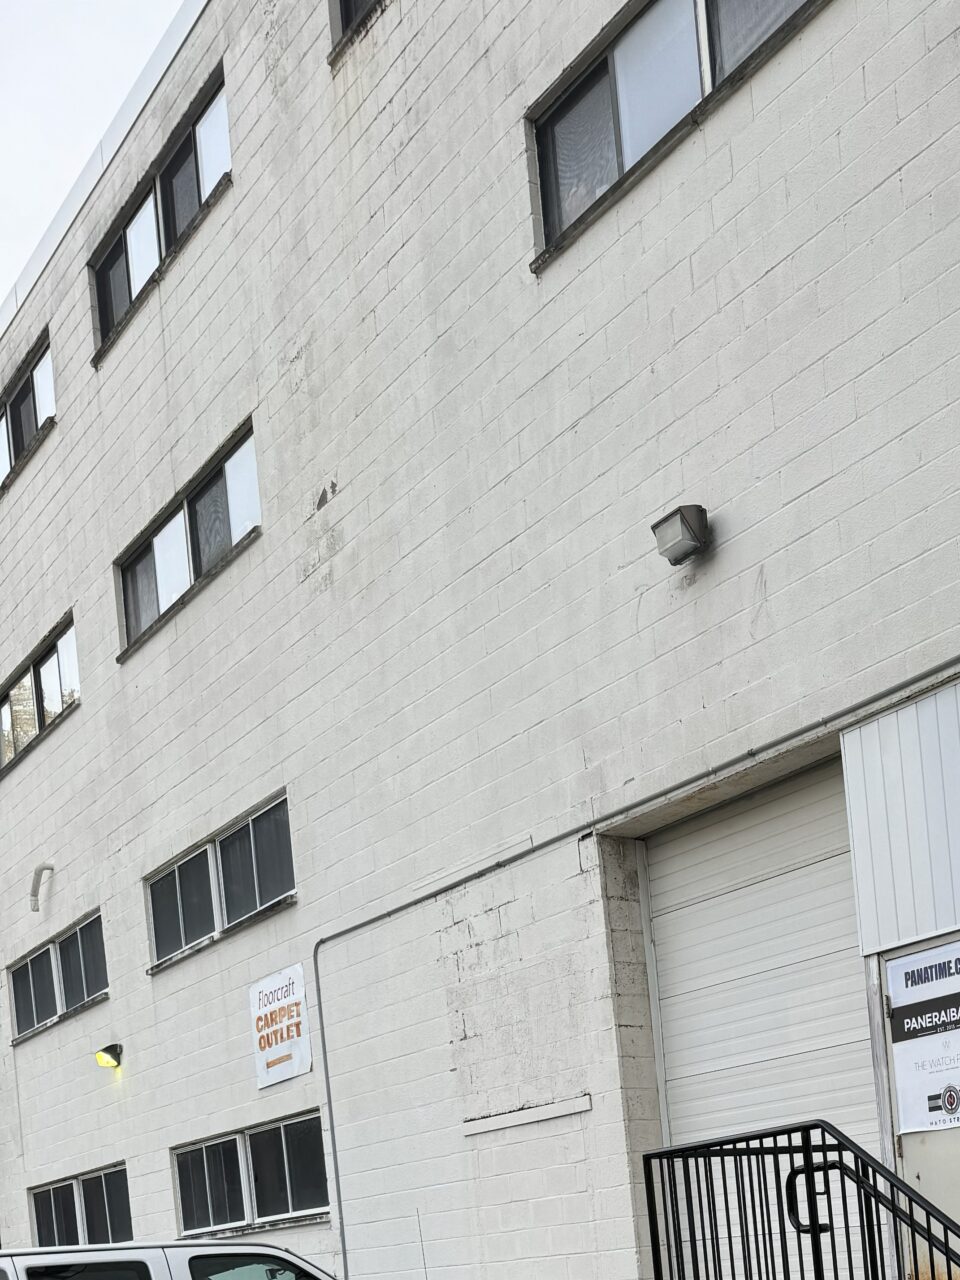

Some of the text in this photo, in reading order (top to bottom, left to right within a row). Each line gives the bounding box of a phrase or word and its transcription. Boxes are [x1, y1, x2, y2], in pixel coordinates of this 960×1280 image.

[258, 977, 295, 1010] Floorcraft
[255, 1001, 302, 1034] CARPET
[258, 1020, 302, 1052] OUTLET
[914, 1060, 927, 1072] THE
[928, 1055, 956, 1069] WATCH
